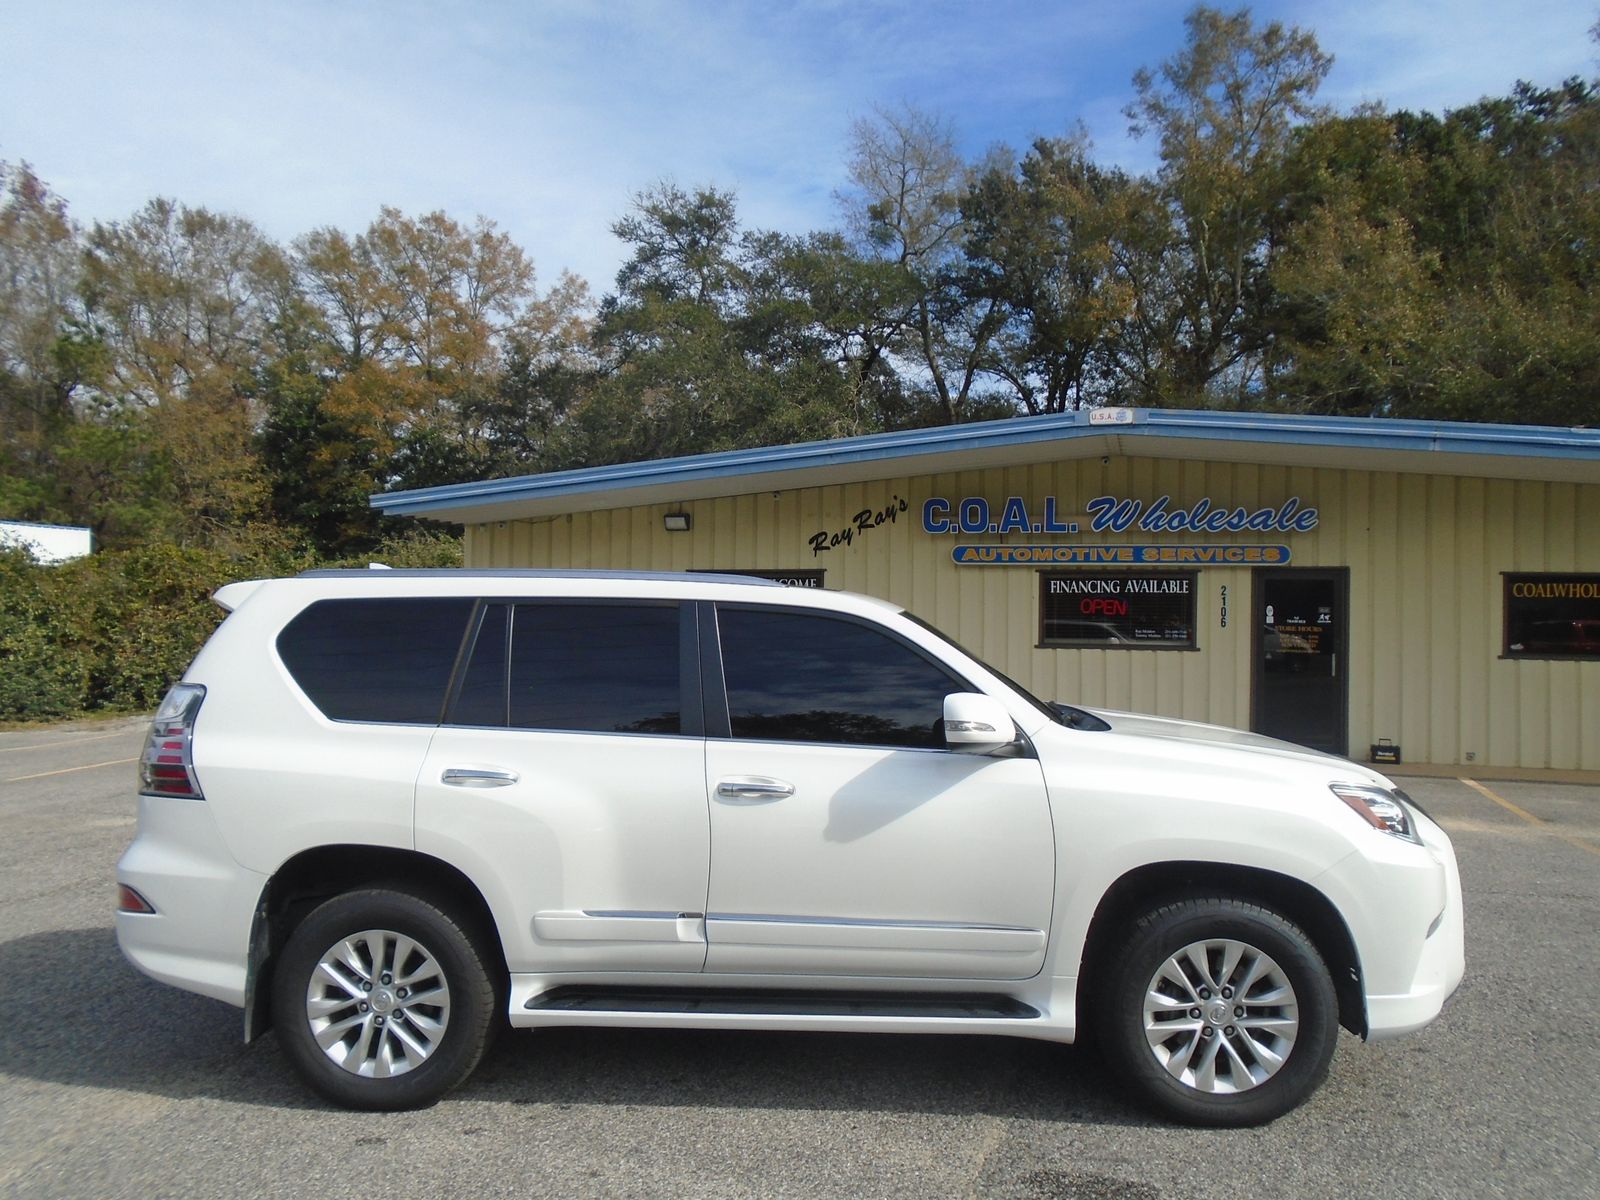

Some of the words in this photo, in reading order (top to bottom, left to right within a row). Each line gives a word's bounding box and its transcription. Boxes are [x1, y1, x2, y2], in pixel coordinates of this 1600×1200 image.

[922, 496, 1079, 534] C.O.A.L.
[1086, 495, 1318, 533] Wholesale
[808, 526, 853, 558] Ray
[853, 495, 908, 536] Ray's
[961, 547, 1134, 562] AUTOMOTIVE
[1141, 547, 1281, 562] SERVICES
[1050, 580, 1120, 594] FINANCING
[1125, 580, 1189, 594] AVAILABLE
[1080, 598, 1129, 616] OPEN
